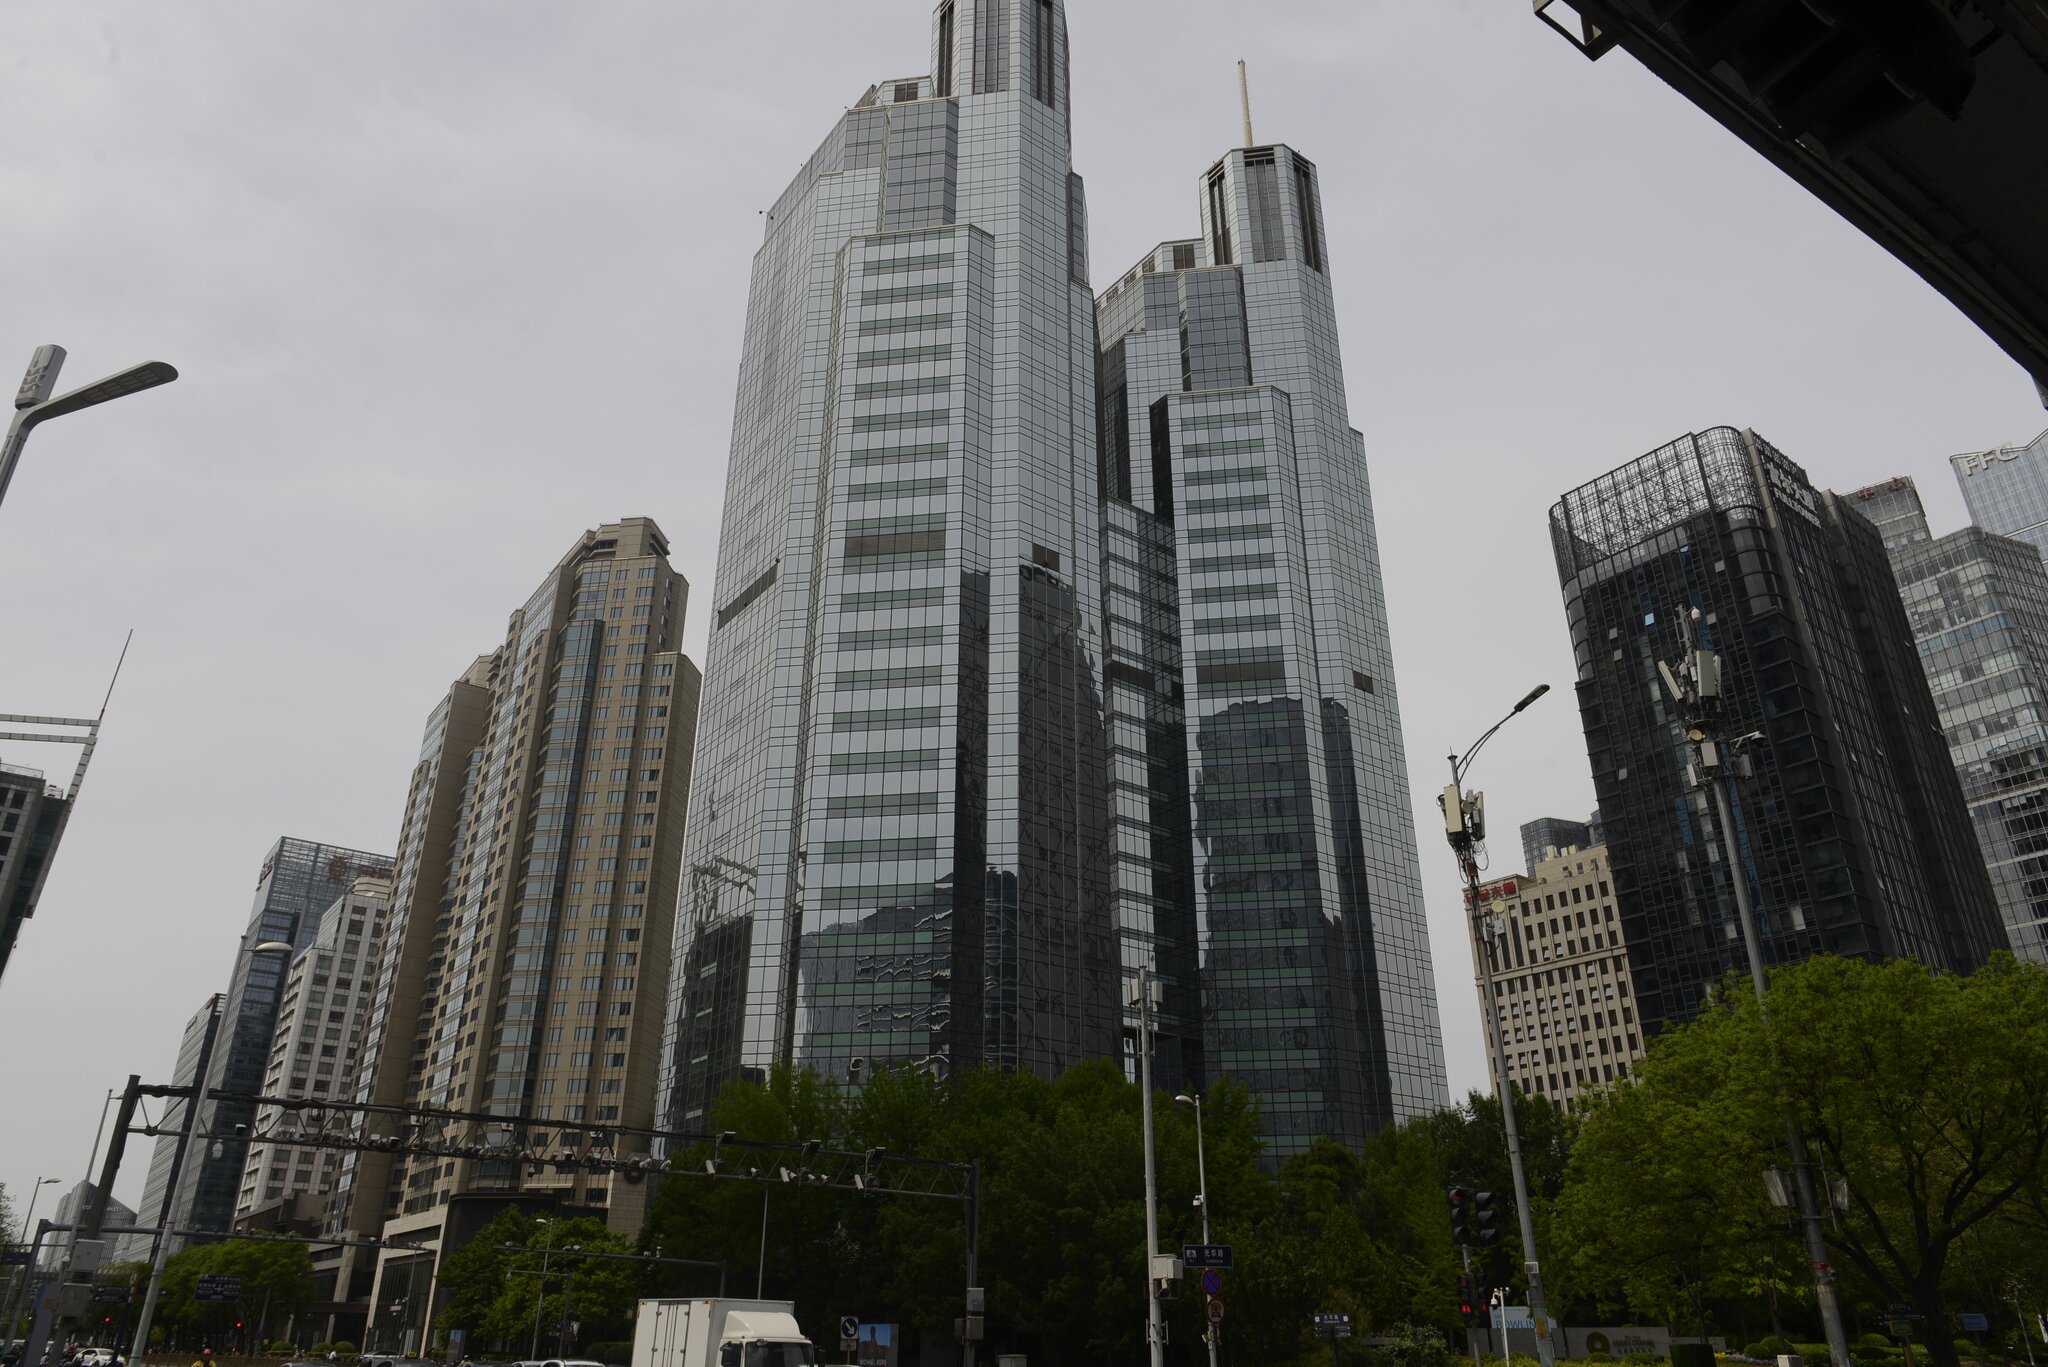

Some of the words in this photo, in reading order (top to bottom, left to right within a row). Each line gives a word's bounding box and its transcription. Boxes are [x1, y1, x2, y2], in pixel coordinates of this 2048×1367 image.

[1963, 441, 2018, 477] FFC
[1204, 1248, 1224, 1258] 光华路
